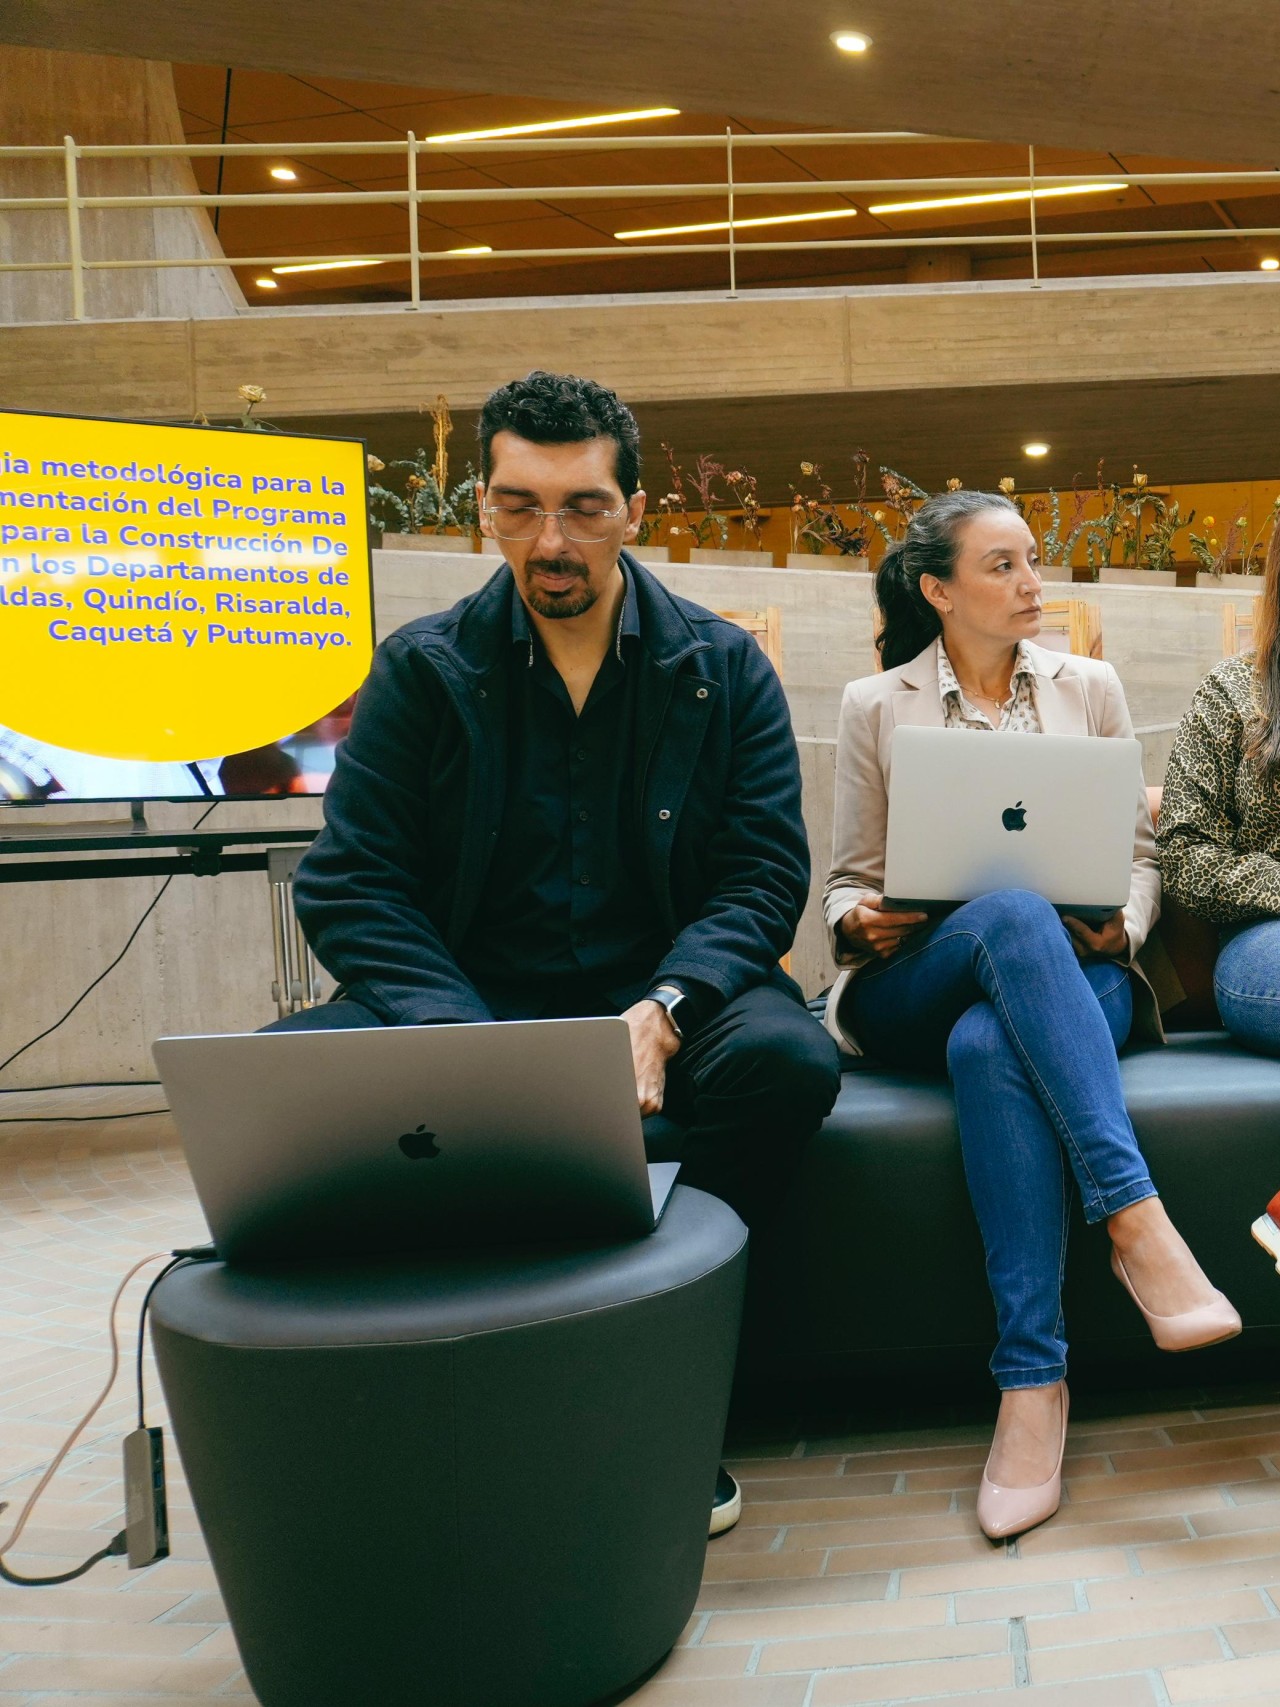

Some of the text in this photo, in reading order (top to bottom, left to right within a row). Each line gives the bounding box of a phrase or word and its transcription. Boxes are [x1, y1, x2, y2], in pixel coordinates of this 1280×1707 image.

[0, 452, 346, 496] ia metodológica para la
[0, 490, 346, 527] mentación del Programa
[1, 523, 348, 556] para la Construcción De
[31, 553, 76, 575] los
[87, 555, 309, 585] Departamentos
[318, 566, 349, 586] de
[84, 588, 206, 614] Quindío,
[215, 592, 351, 619] Risaralda,
[49, 619, 352, 650] Caquetá y Putumayo.
